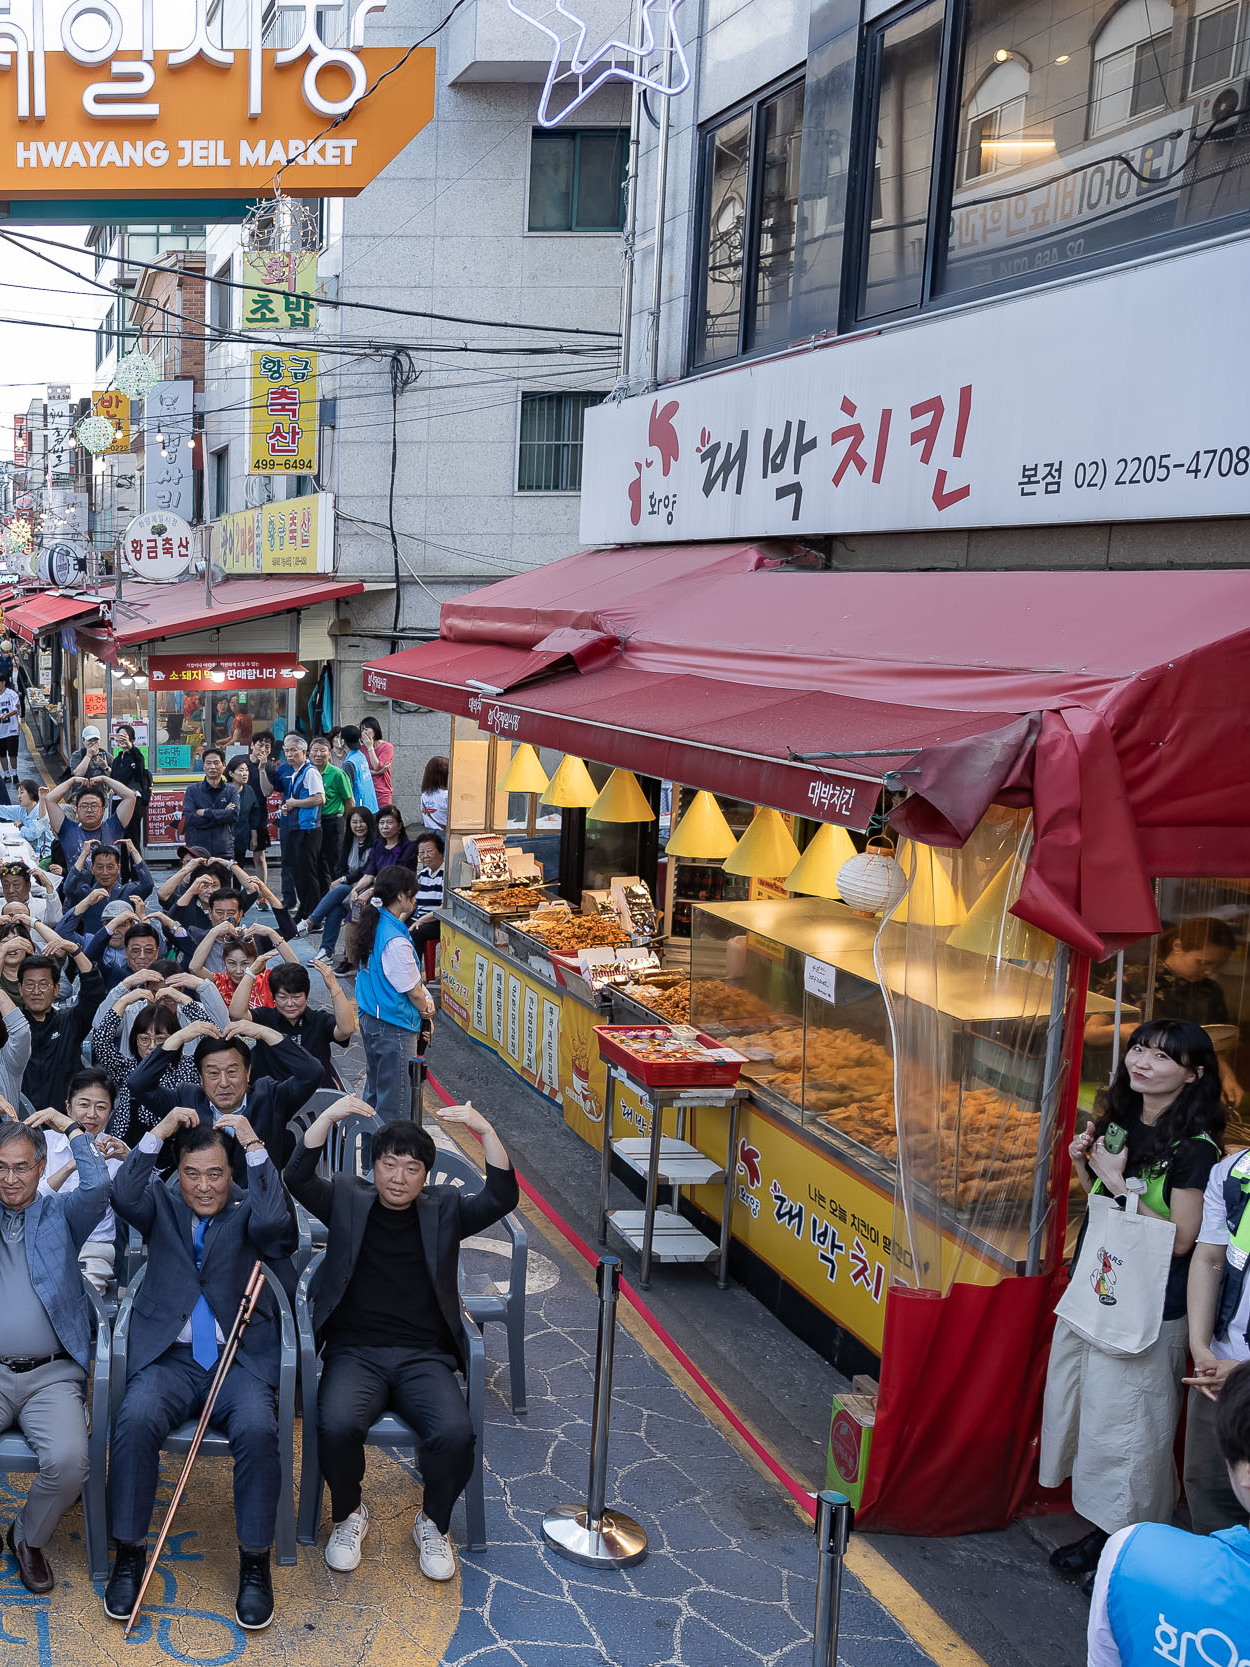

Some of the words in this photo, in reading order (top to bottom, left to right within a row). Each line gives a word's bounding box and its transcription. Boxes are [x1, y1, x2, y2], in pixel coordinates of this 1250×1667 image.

[17, 139, 168, 169] HWAYANG
[177, 139, 230, 168] JEIL
[240, 138, 358, 168] MARKET
[246, 292, 315, 328] 초밥
[260, 356, 312, 382] 황금
[267, 386, 302, 456] 축산
[254, 458, 313, 471] 499-6494
[696, 384, 973, 521] 대박치킨
[1018, 460, 1064, 497] 본점
[1073, 457, 1109, 490] 02)
[1114, 445, 1250, 489] 2205-4708
[268, 507, 311, 551] 황금축산
[131, 537, 189, 561] 황금축산
[227, 668, 276, 681] 판매합니다
[807, 780, 856, 816] 대박치킨
[808, 1183, 827, 1207] 나는
[829, 1199, 847, 1221] 오늘
[850, 1213, 880, 1246] 치킨이
[770, 1179, 885, 1305] 대박치
